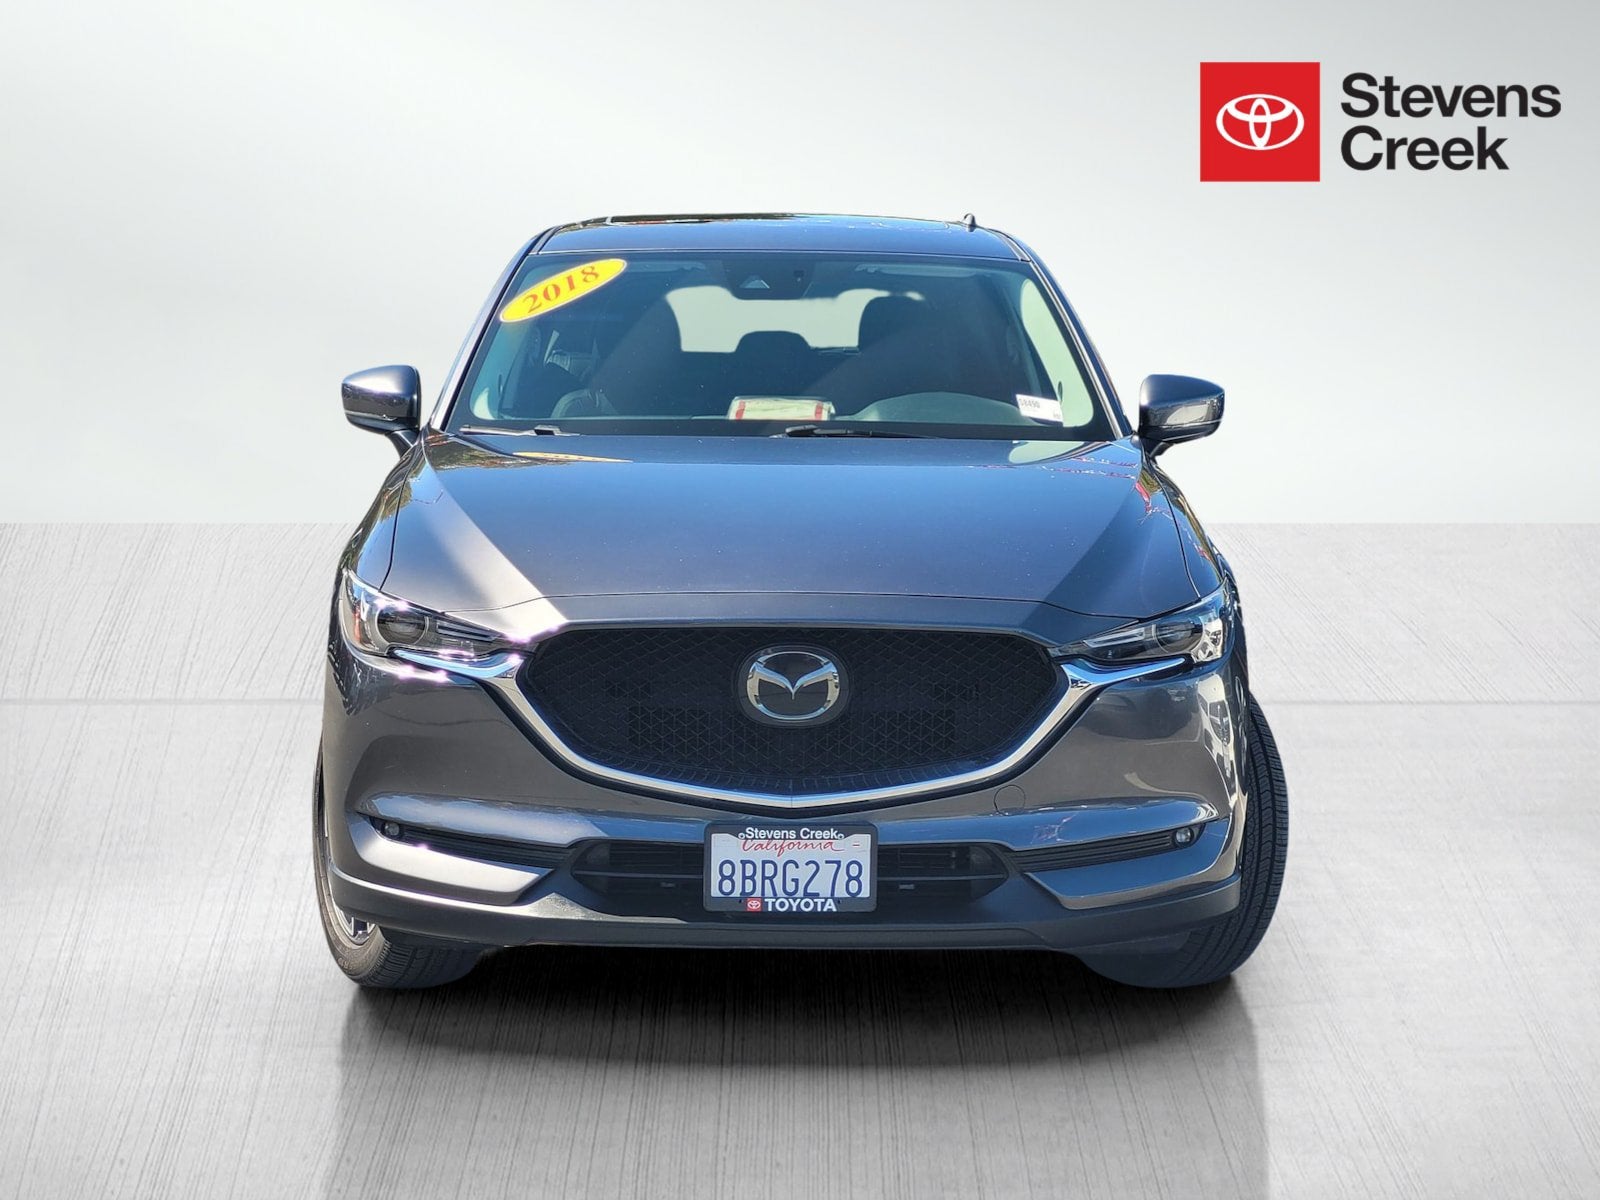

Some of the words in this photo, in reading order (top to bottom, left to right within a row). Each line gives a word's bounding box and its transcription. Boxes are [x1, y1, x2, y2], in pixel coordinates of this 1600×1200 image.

[523, 265, 600, 314] 2018
[745, 827, 797, 840] Stevens
[799, 827, 839, 840] Creek
[742, 839, 845, 858] California
[717, 859, 864, 898] 8BRG278
[764, 897, 838, 912] TOYOTA
